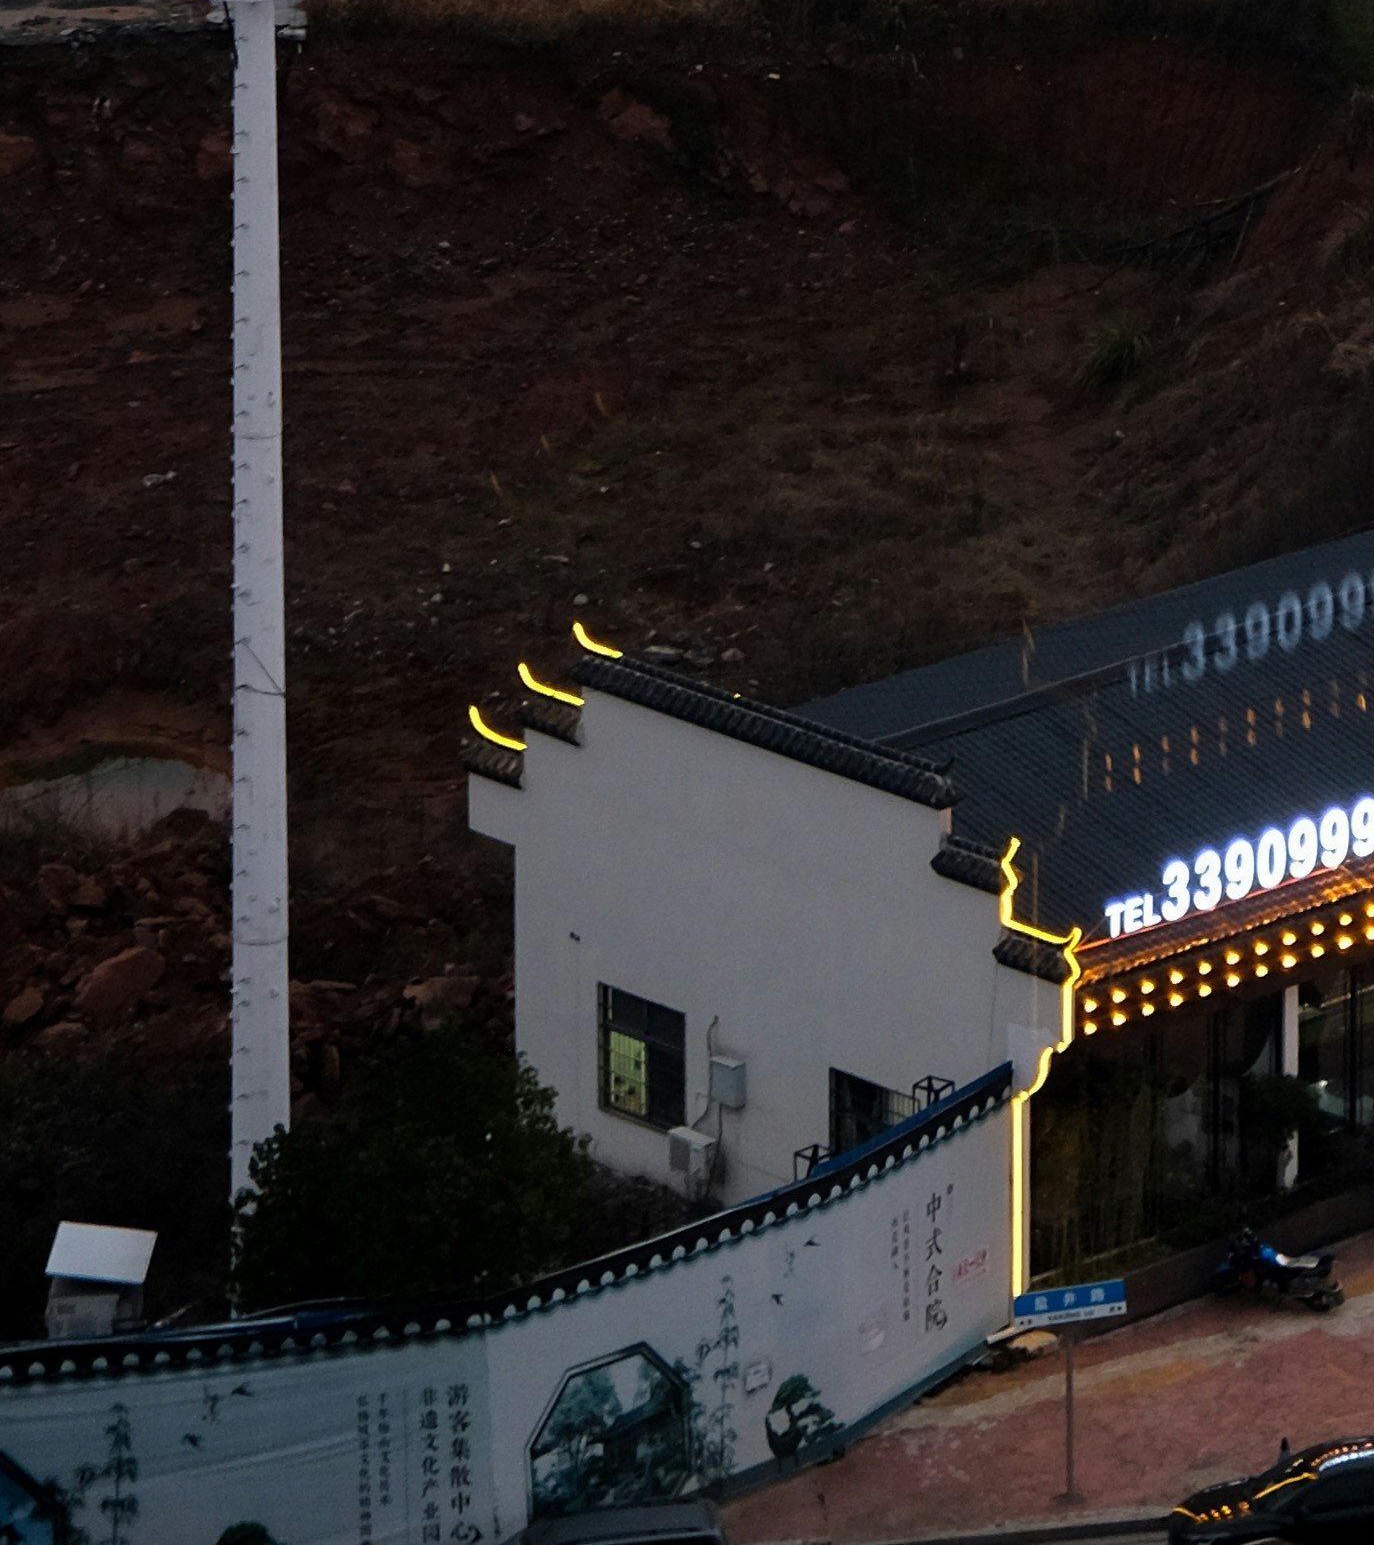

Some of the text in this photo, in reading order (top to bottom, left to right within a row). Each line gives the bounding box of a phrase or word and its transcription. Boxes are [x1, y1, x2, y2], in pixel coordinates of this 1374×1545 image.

[1104, 891, 1163, 939] TEL
[926, 1192, 947, 1333] 中式合院
[447, 1383, 483, 1542] 游客集散中心
